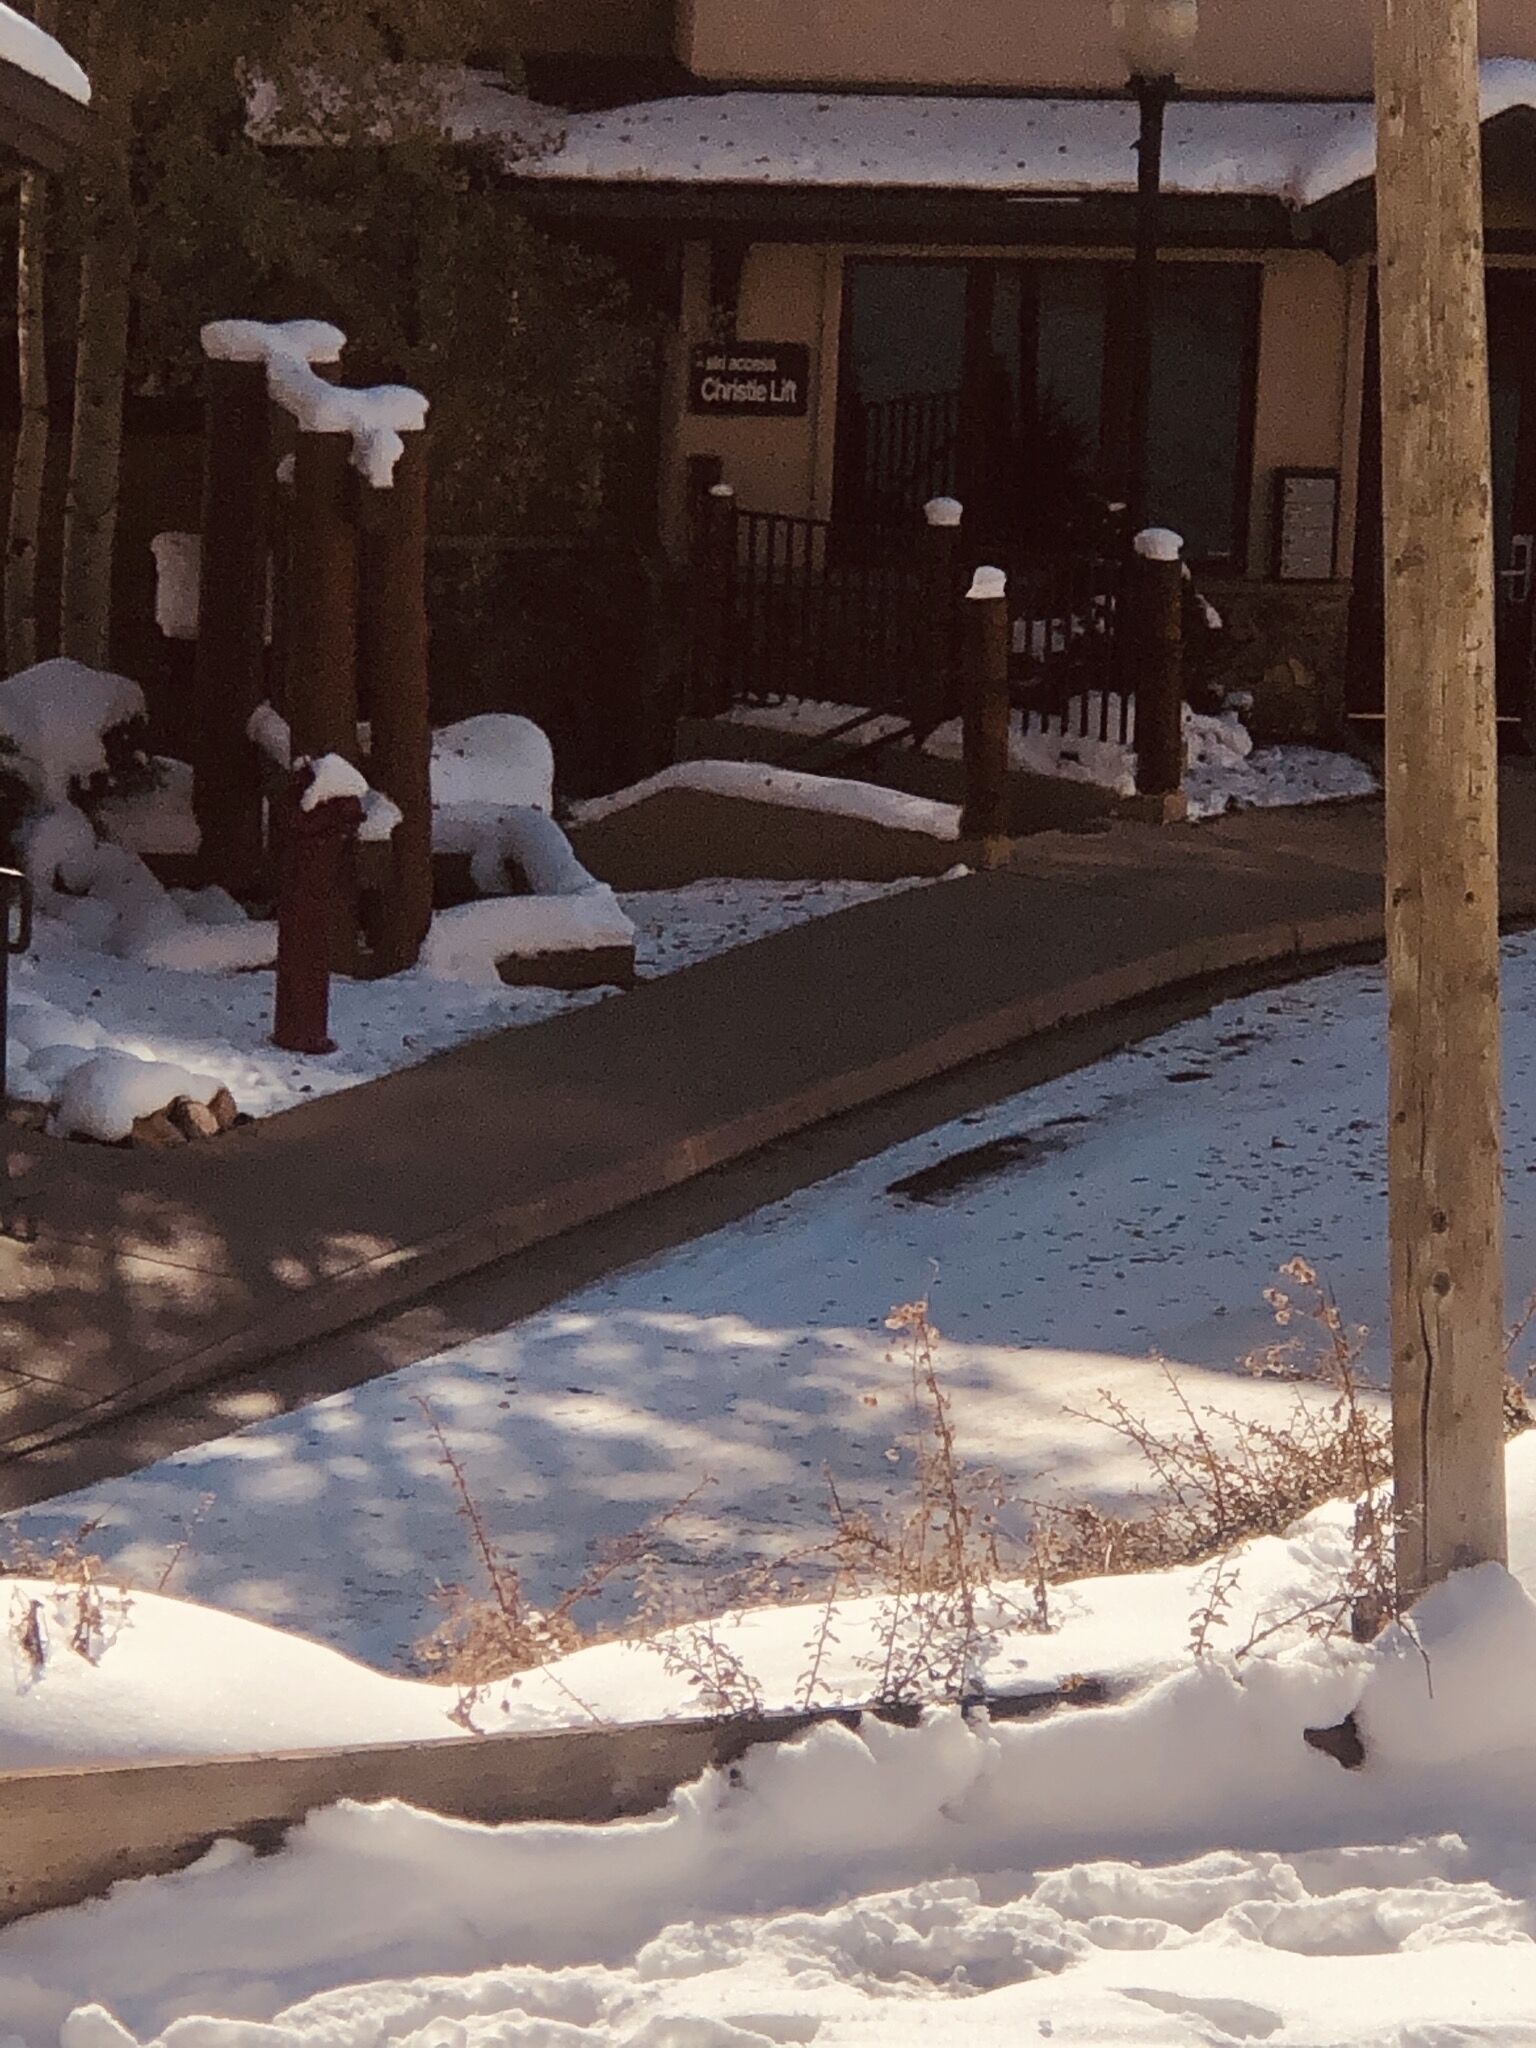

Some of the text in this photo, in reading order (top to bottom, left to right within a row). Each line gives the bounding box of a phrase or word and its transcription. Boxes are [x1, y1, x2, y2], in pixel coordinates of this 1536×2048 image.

[727, 357, 777, 371] access
[701, 377, 796, 403] Christie Lift
